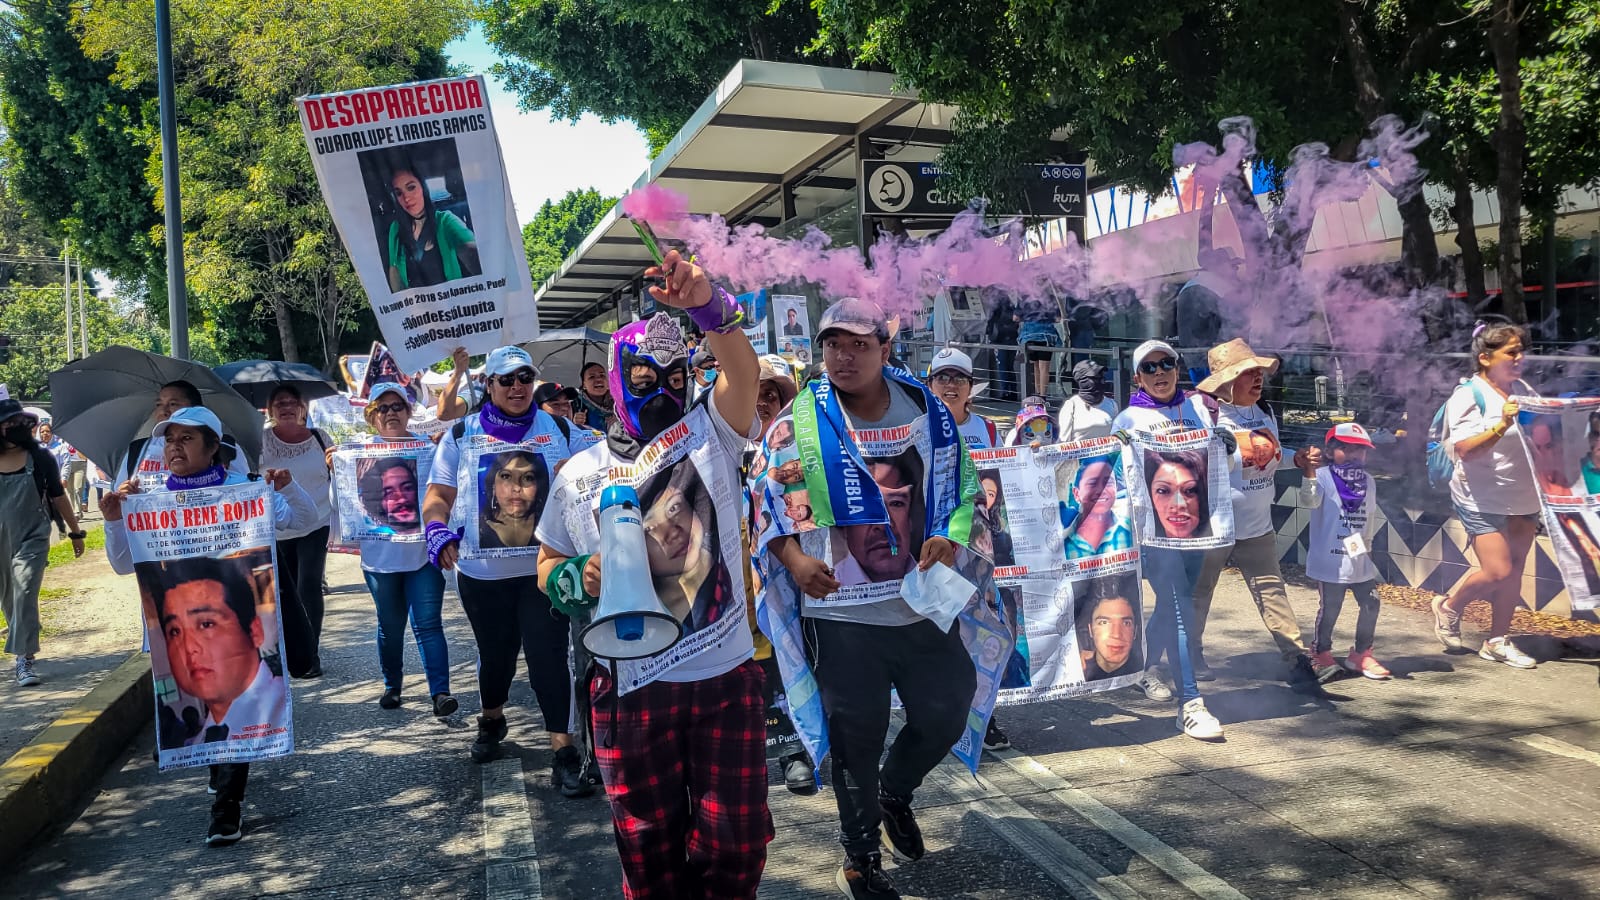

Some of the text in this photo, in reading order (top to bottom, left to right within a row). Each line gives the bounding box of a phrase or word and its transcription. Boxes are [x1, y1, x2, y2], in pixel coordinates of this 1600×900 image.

[304, 79, 483, 131] DESAPARECIDA
[315, 114, 487, 155] GUADALUPE LARIOS RAMOS
[1053, 193, 1080, 204] RUTA
[404, 296, 414, 306] de
[414, 292, 436, 304] 2018
[127, 509, 178, 532] CARLOS
[183, 502, 219, 527] RENE
[223, 497, 265, 522] ROJAS
[170, 530, 182, 538] VIO
[183, 528, 198, 537] POR
[199, 525, 226, 535] ULTIMA
[227, 522, 240, 530] VEZ
[160, 539, 169, 548] DE
[170, 535, 213, 547] NOVIEMBRE
[214, 533, 228, 542] DEL
[164, 549, 171, 557] EL
[174, 546, 201, 556] ESTADO
[202, 545, 213, 553] DE
[214, 541, 242, 552] JALISCO
[680, 637, 697, 650] sabes
